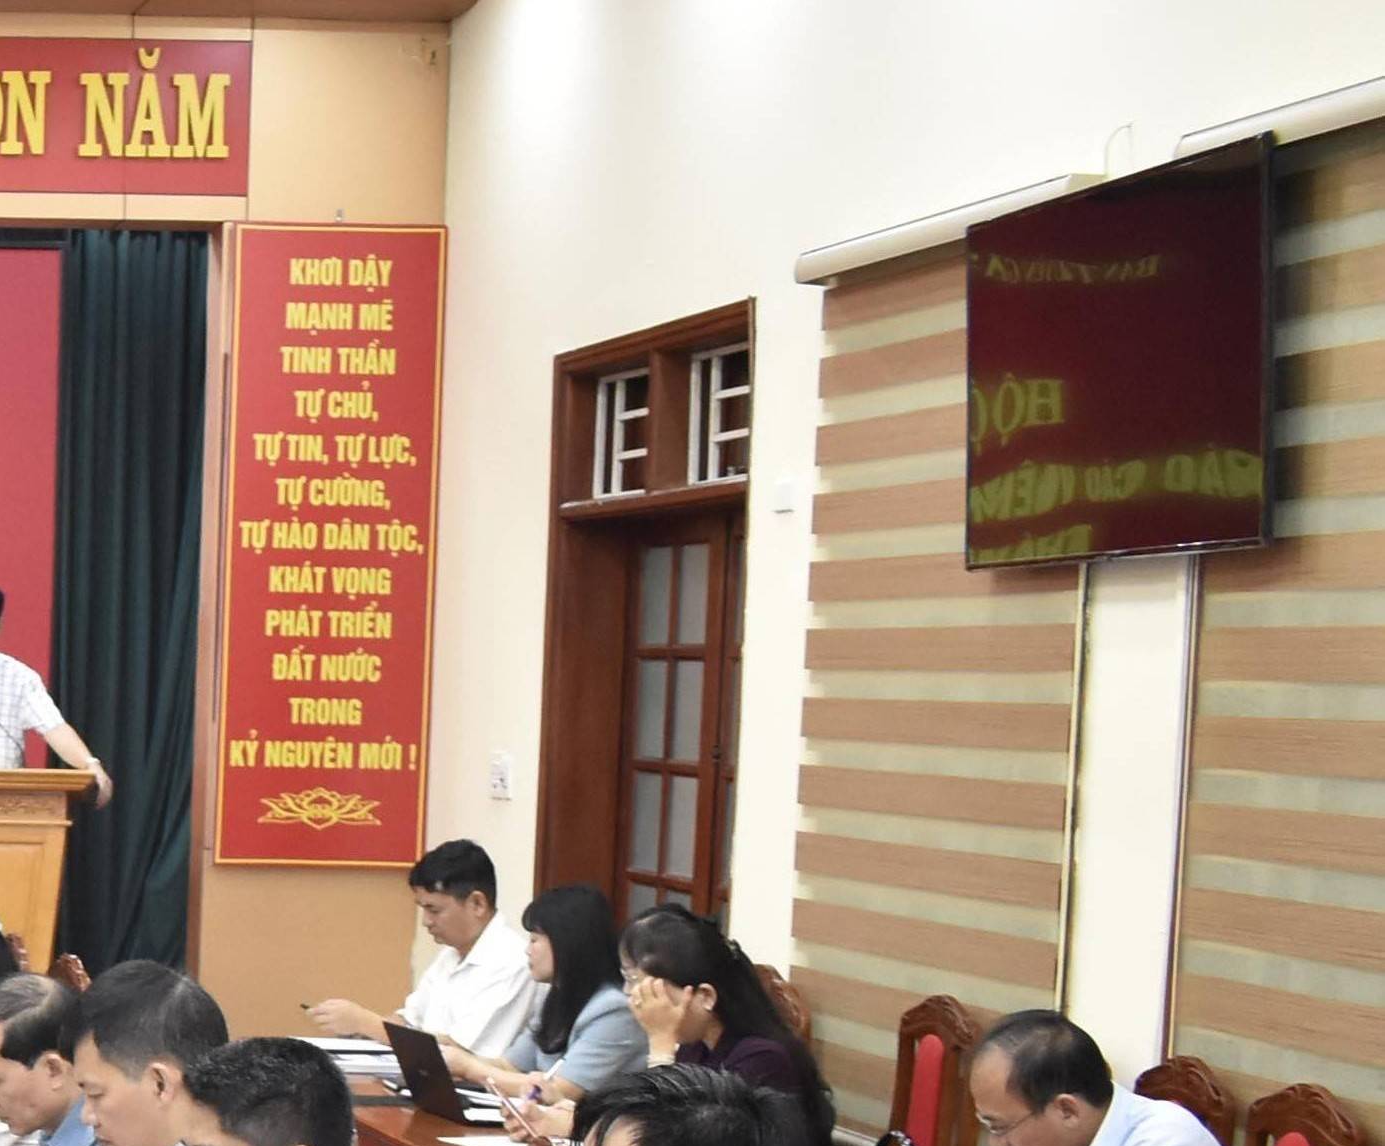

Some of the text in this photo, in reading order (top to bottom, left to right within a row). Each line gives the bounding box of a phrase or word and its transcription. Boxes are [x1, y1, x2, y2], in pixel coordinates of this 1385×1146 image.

[79, 48, 231, 157] NĂM
[290, 254, 392, 292] KHƠI DẬY
[285, 299, 393, 335] MẠNH MẼ
[280, 339, 396, 375] TINH THẦN
[294, 381, 378, 423] TỰ CHỦ,
[253, 432, 416, 468] TỰ TIN, TỰ LỰC,
[276, 473, 390, 510] TỰ CƯỜNG,
[239, 517, 423, 556] TỰ HÀO DÂN TỘC,
[269, 561, 391, 599] KHÁT VỌNG
[266, 601, 392, 638] PHÁT TRIỂN
[273, 646, 381, 682] ĐẤT NƯỚC
[290, 698, 362, 725] TRONG
[230, 730, 416, 770] KỶ NGUYÊN MỚI !
